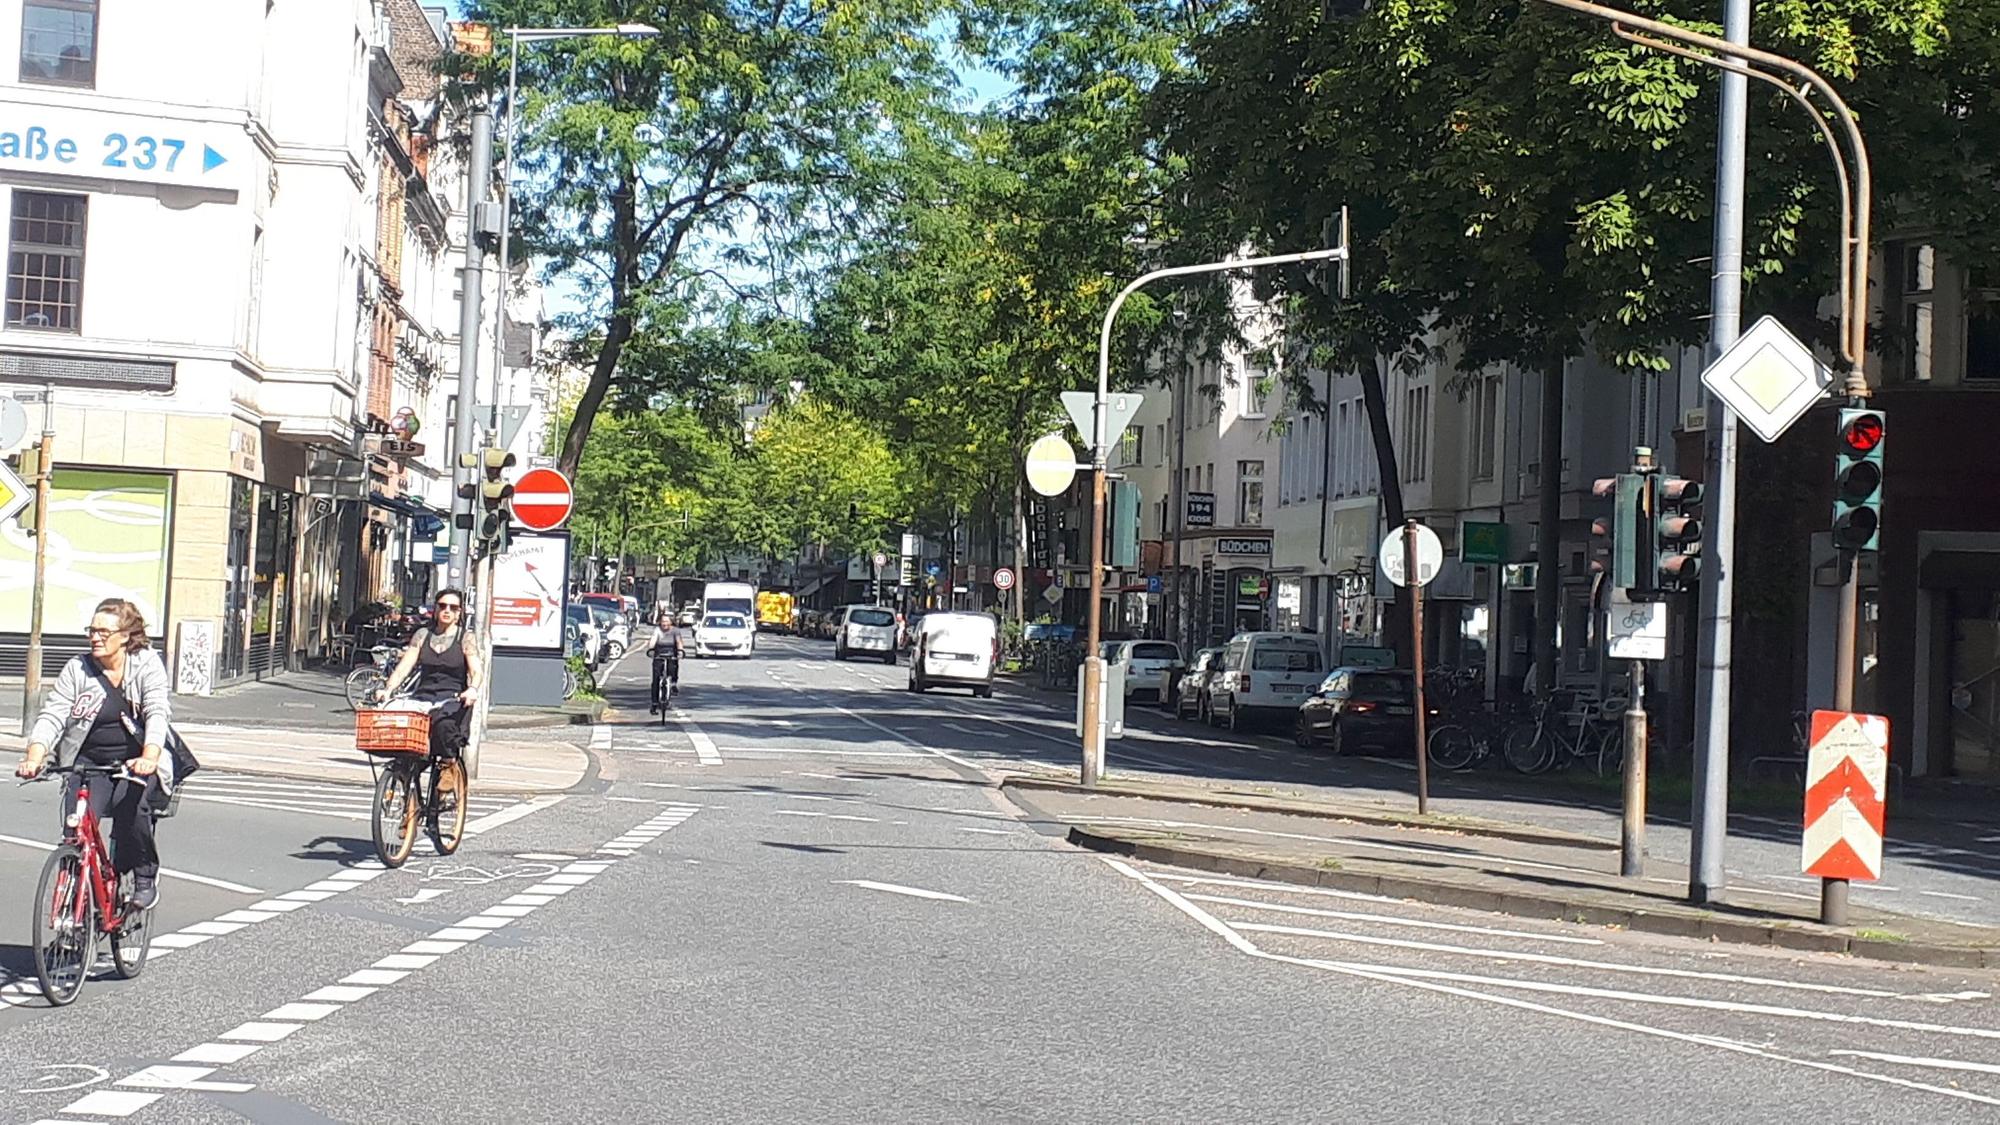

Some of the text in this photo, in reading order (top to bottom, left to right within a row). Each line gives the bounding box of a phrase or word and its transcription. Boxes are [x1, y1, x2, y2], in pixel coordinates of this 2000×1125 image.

[0, 126, 186, 172] aße 237
[390, 441, 416, 452] EIS
[1190, 504, 1211, 513] 194
[1220, 540, 1269, 554] BÜDCHEN
[999, 574, 1010, 584] 30
